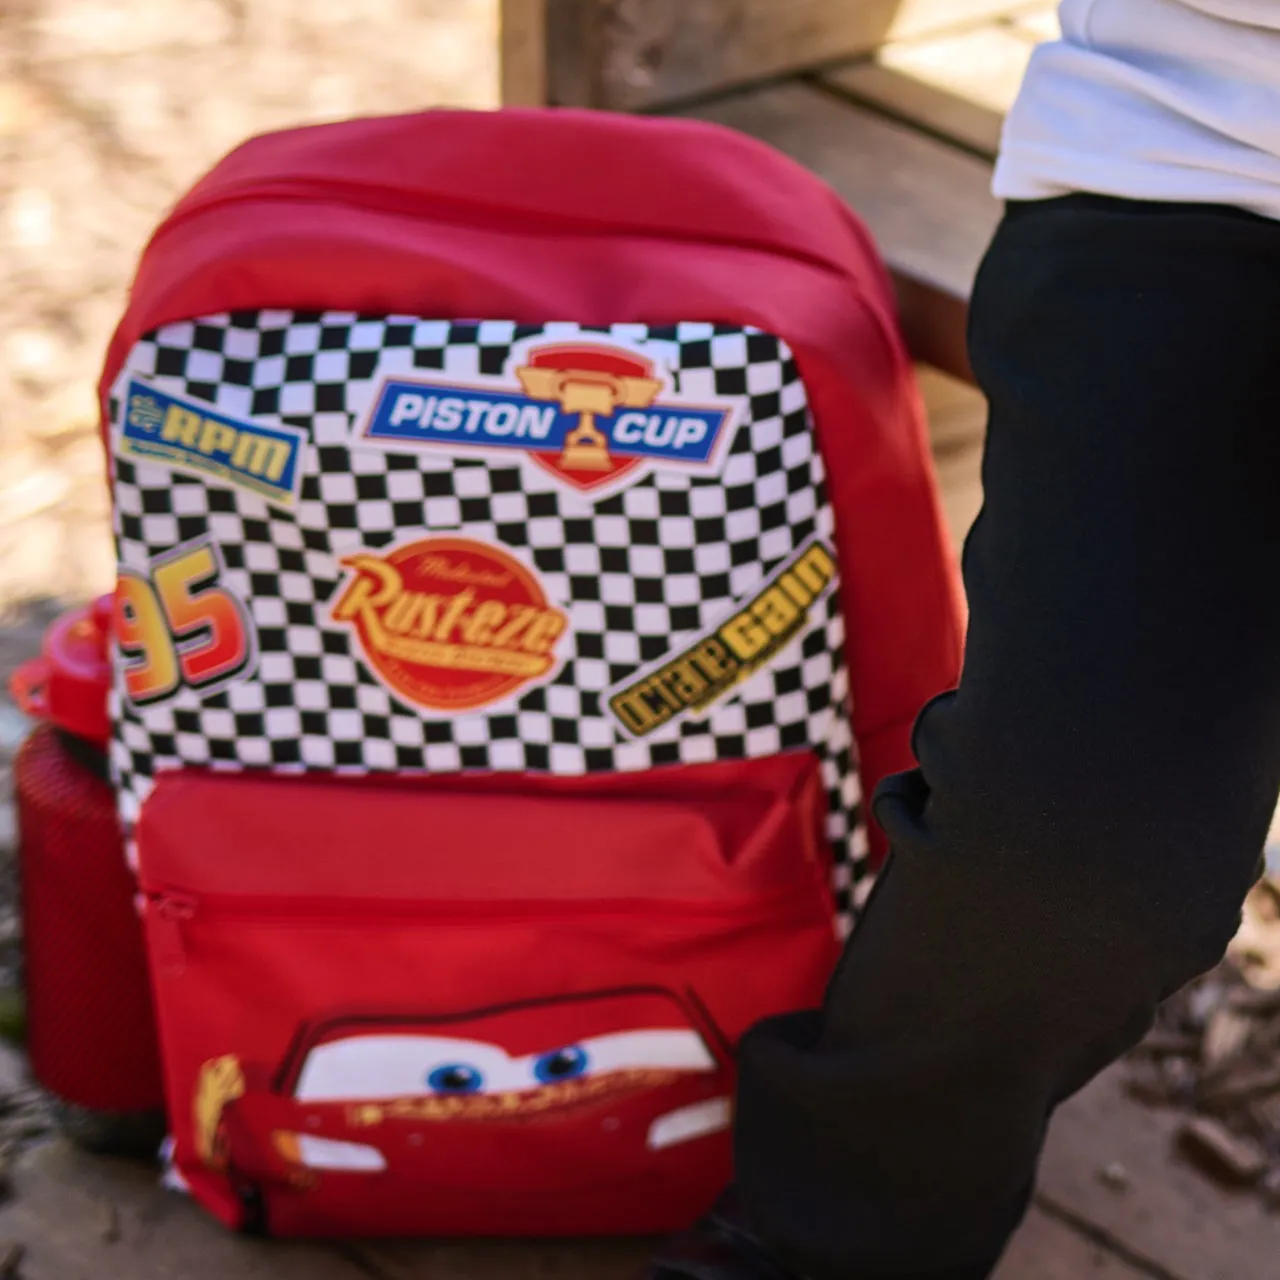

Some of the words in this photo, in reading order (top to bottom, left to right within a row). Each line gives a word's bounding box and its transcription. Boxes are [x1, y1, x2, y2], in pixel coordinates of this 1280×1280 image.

[160, 404, 293, 485] RPM
[388, 392, 556, 440] PISTON
[612, 410, 709, 450] CUP
[112, 546, 249, 704] 95
